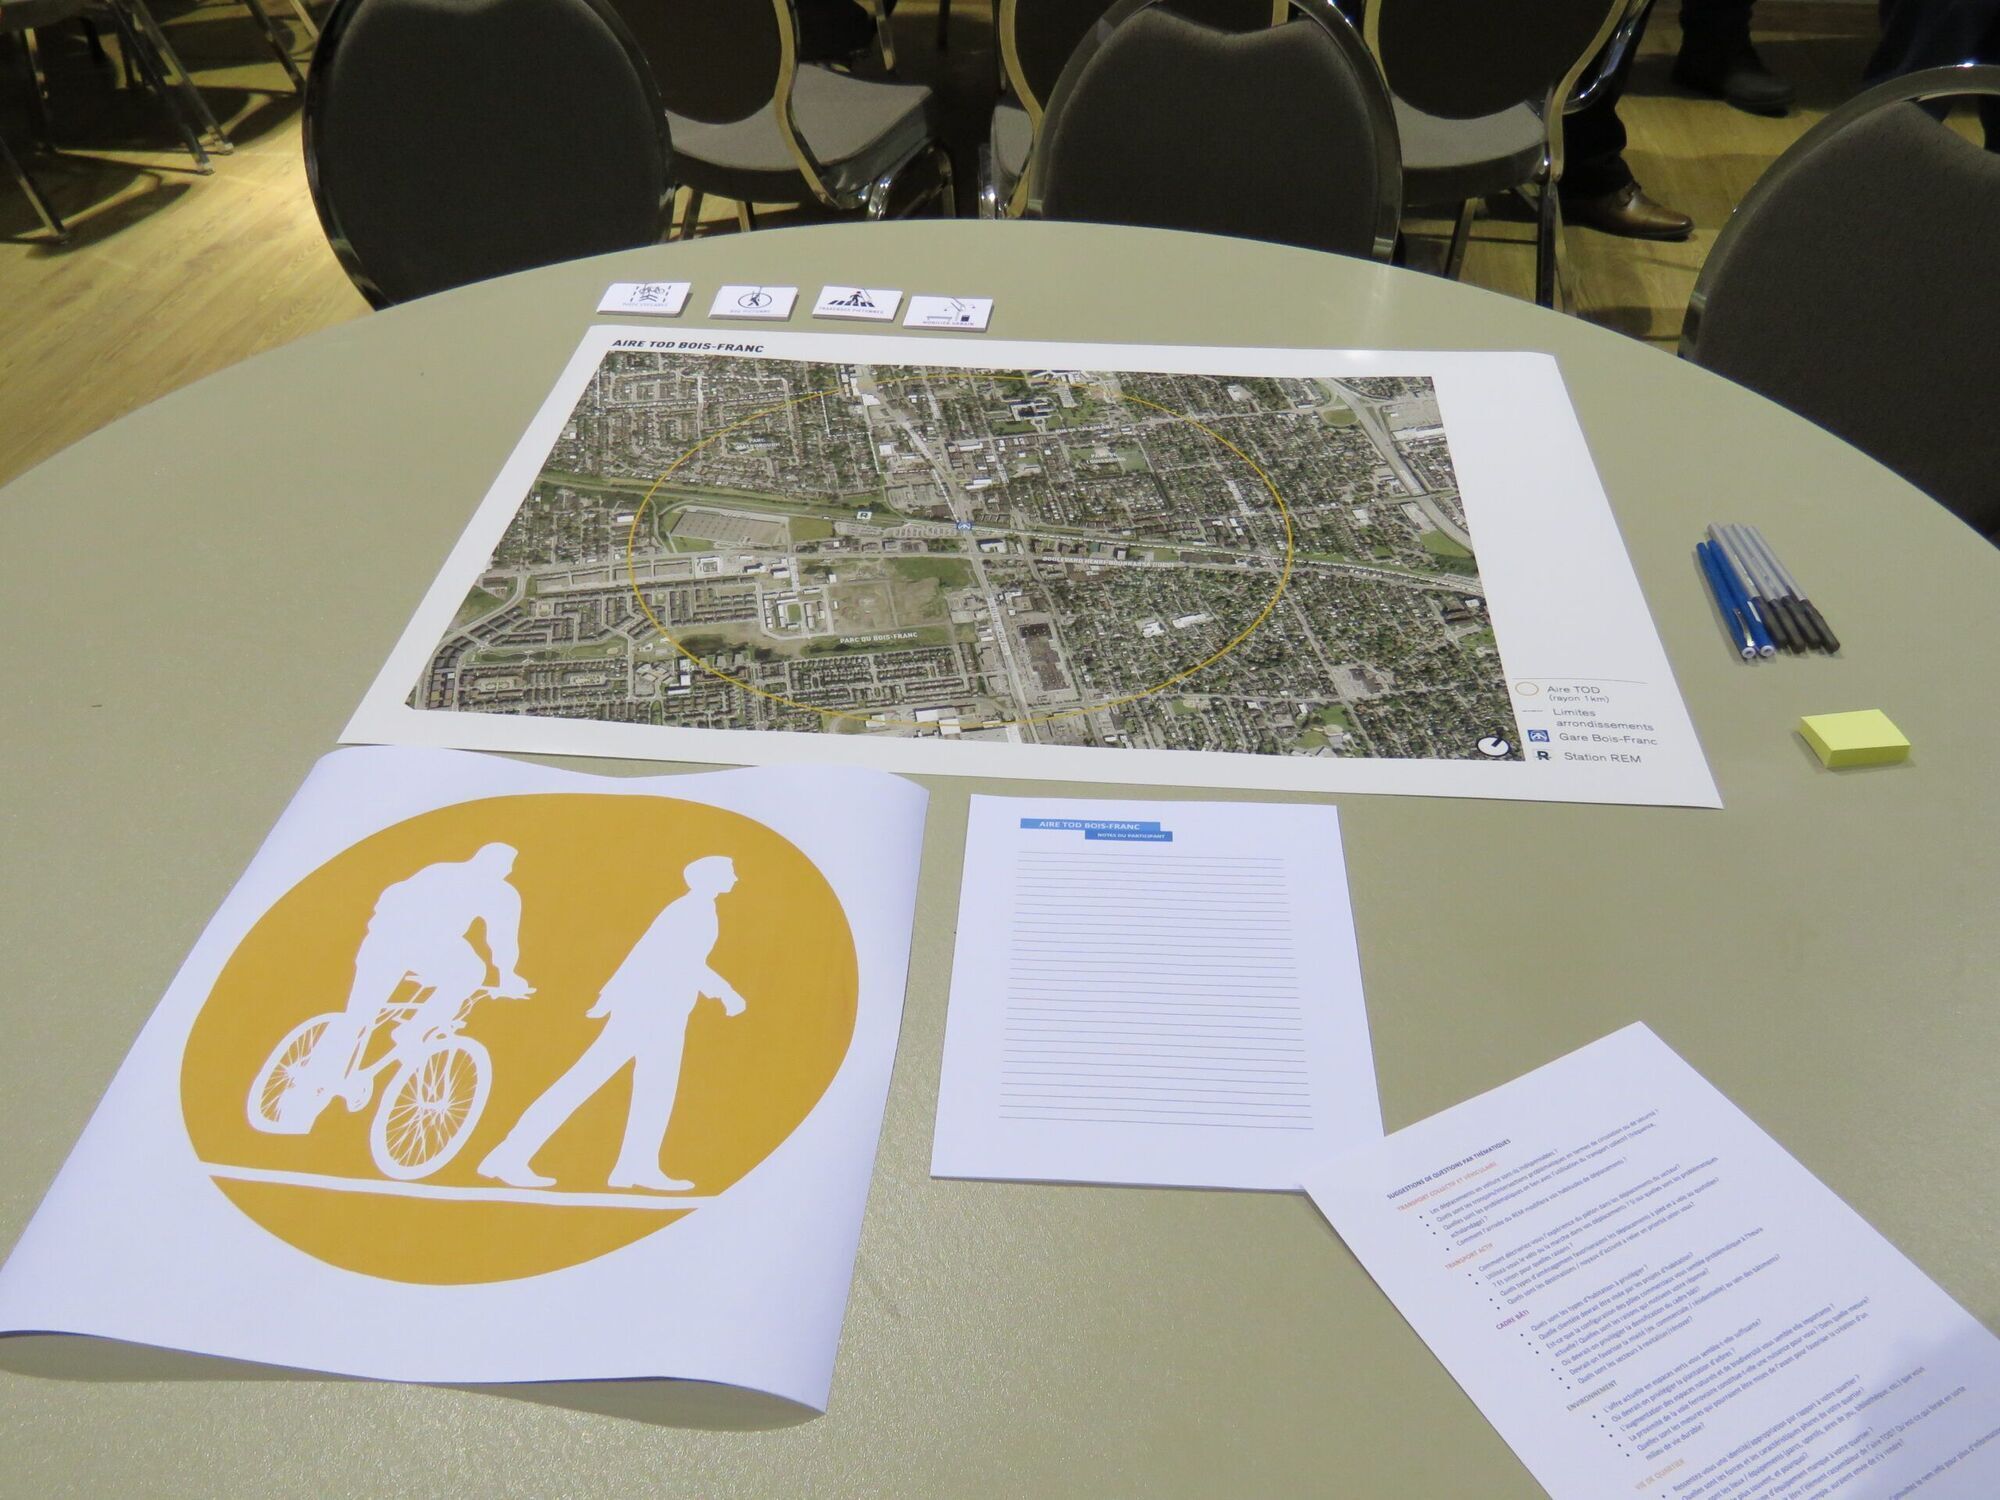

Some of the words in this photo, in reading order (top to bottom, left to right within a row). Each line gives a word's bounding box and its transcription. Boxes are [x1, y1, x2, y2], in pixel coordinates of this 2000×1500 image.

[612, 339, 645, 348] AIRE
[650, 341, 675, 349] TOD
[678, 342, 764, 353] BOIS-FRANC
[873, 632, 918, 641] BOIS-FRANC
[1549, 695, 1581, 703] (rayon
[1553, 709, 1596, 717] Limites
[1556, 720, 1654, 731] arrondissements
[1559, 733, 1588, 742] Gare
[1592, 734, 1658, 745] Bois-Franc
[1537, 750, 1549, 760] R
[1564, 752, 1607, 761] Station
[1611, 754, 1641, 763] REM
[1387, 1179, 1425, 1199] SUGGESTIONS
[1432, 1161, 1463, 1178] QUESTIONS
[1473, 1138, 1510, 1158] THÉMATIQUES
[1397, 1193, 1430, 1211] TRANSPORT
[1428, 1181, 1456, 1196] COLLECTIF
[1444, 1250, 1477, 1269] TRANSPORT
[1494, 1316, 1515, 1329] CADRE
[1565, 1380, 1618, 1411] ENVIRONNEMENT
[1652, 1457, 1685, 1479] QUARTIER
